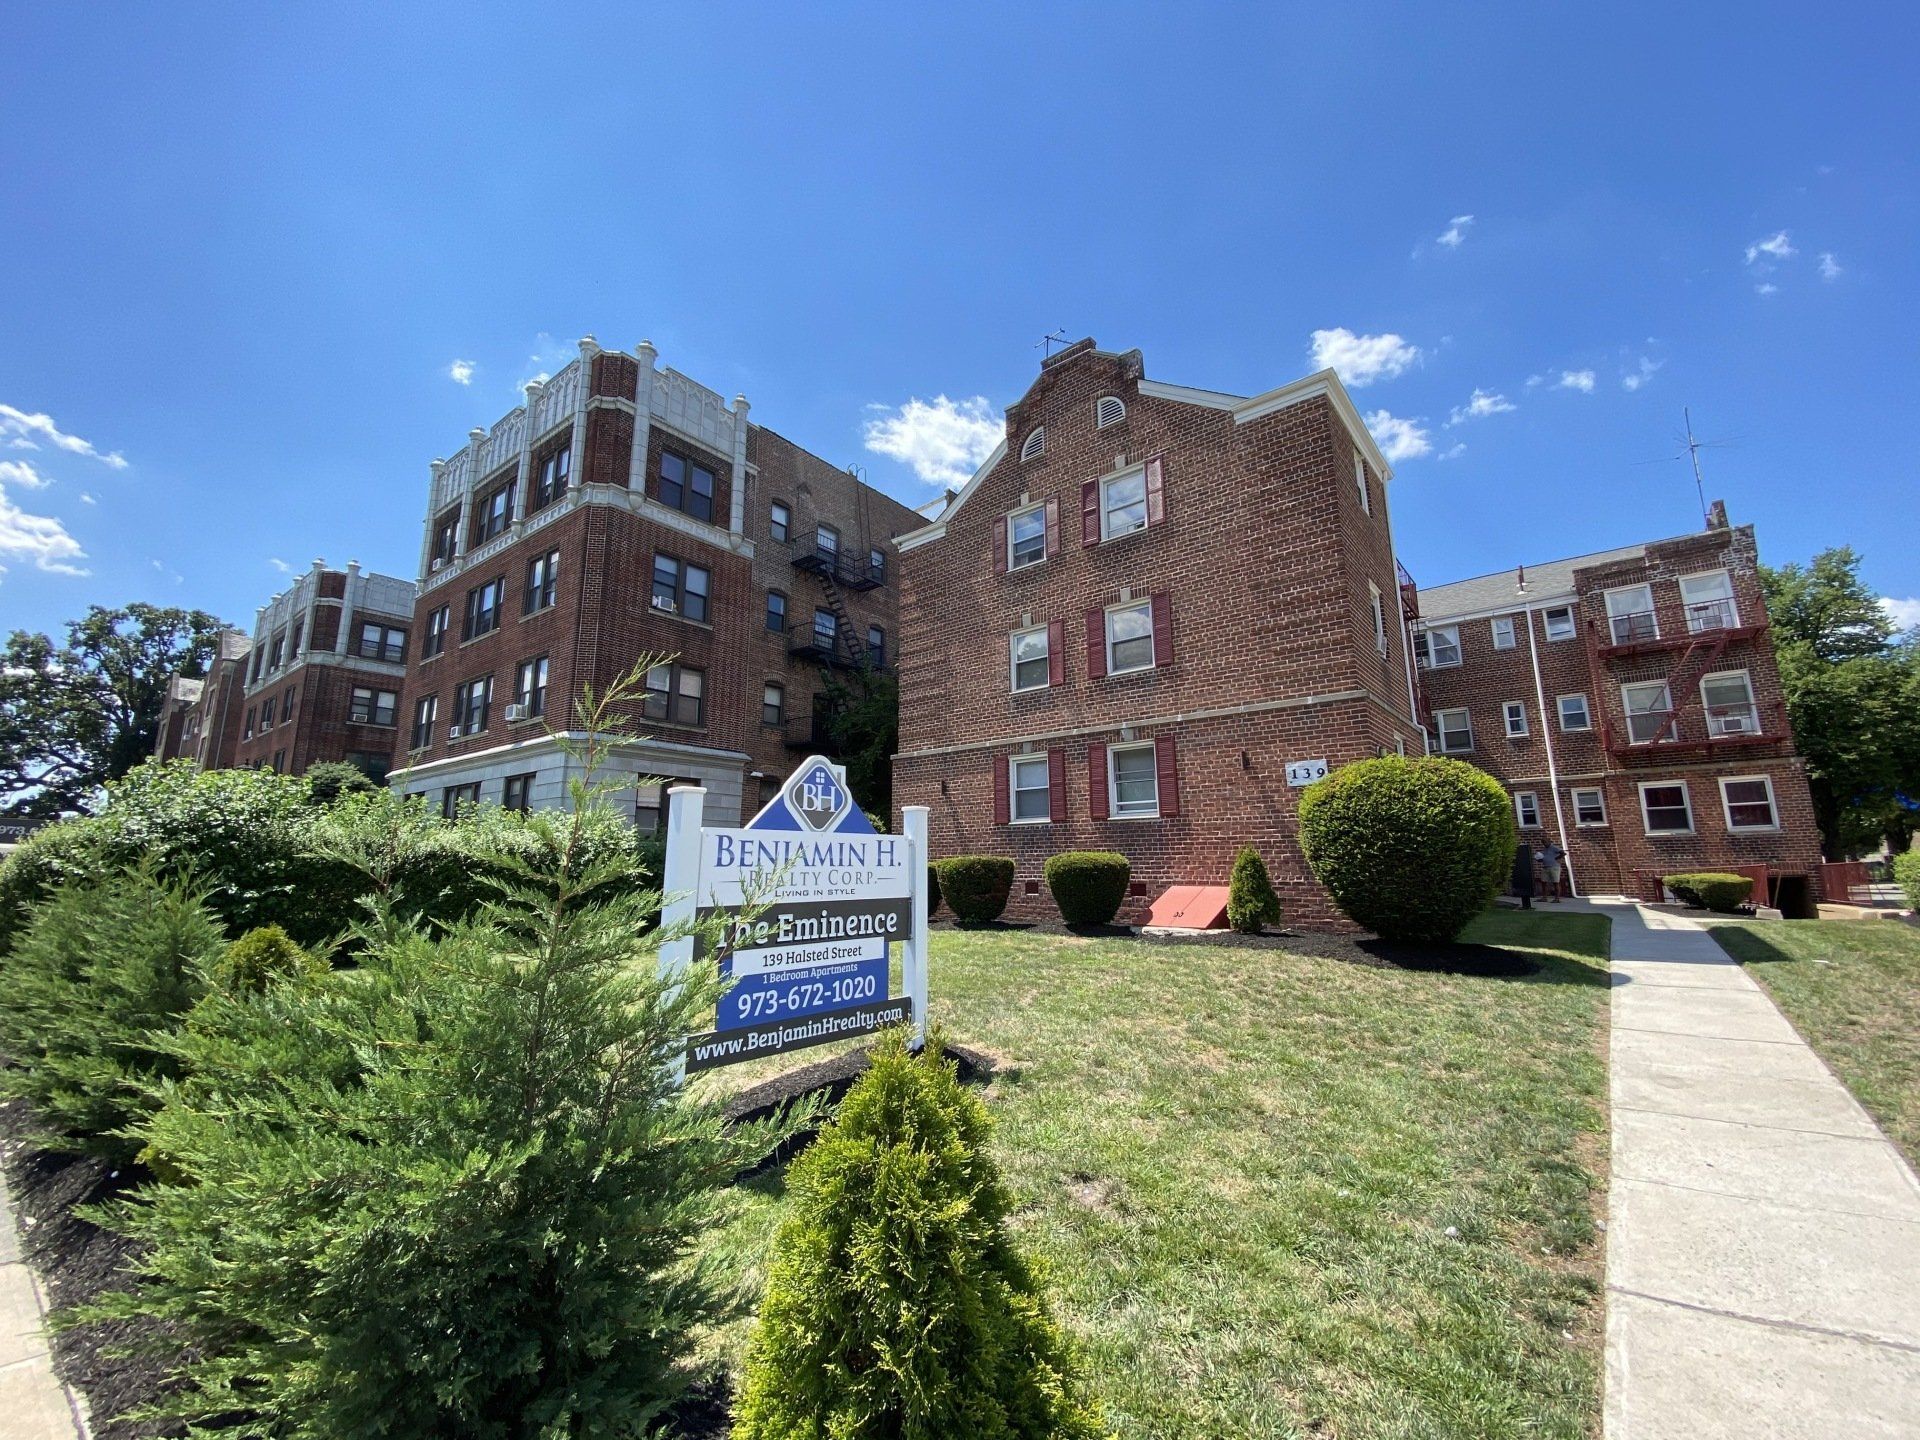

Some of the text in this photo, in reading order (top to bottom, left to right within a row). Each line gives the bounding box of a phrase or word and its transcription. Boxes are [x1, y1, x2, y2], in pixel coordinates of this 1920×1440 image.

[1291, 767, 1325, 780] 139
[800, 783, 837, 813] BH
[714, 834, 902, 868] BENJAMIN H.
[828, 869, 877, 886] CORP.
[774, 889, 809, 898] LIVING
[827, 888, 856, 896] STYLE
[776, 909, 898, 943] Eminence
[763, 945, 862, 968] 139 Halsted Street
[763, 963, 858, 984] 1 Bedroom Apartments
[738, 975, 876, 1019] 973-672-1020
[694, 1006, 903, 1061] www.BenjaminHrealty.com
